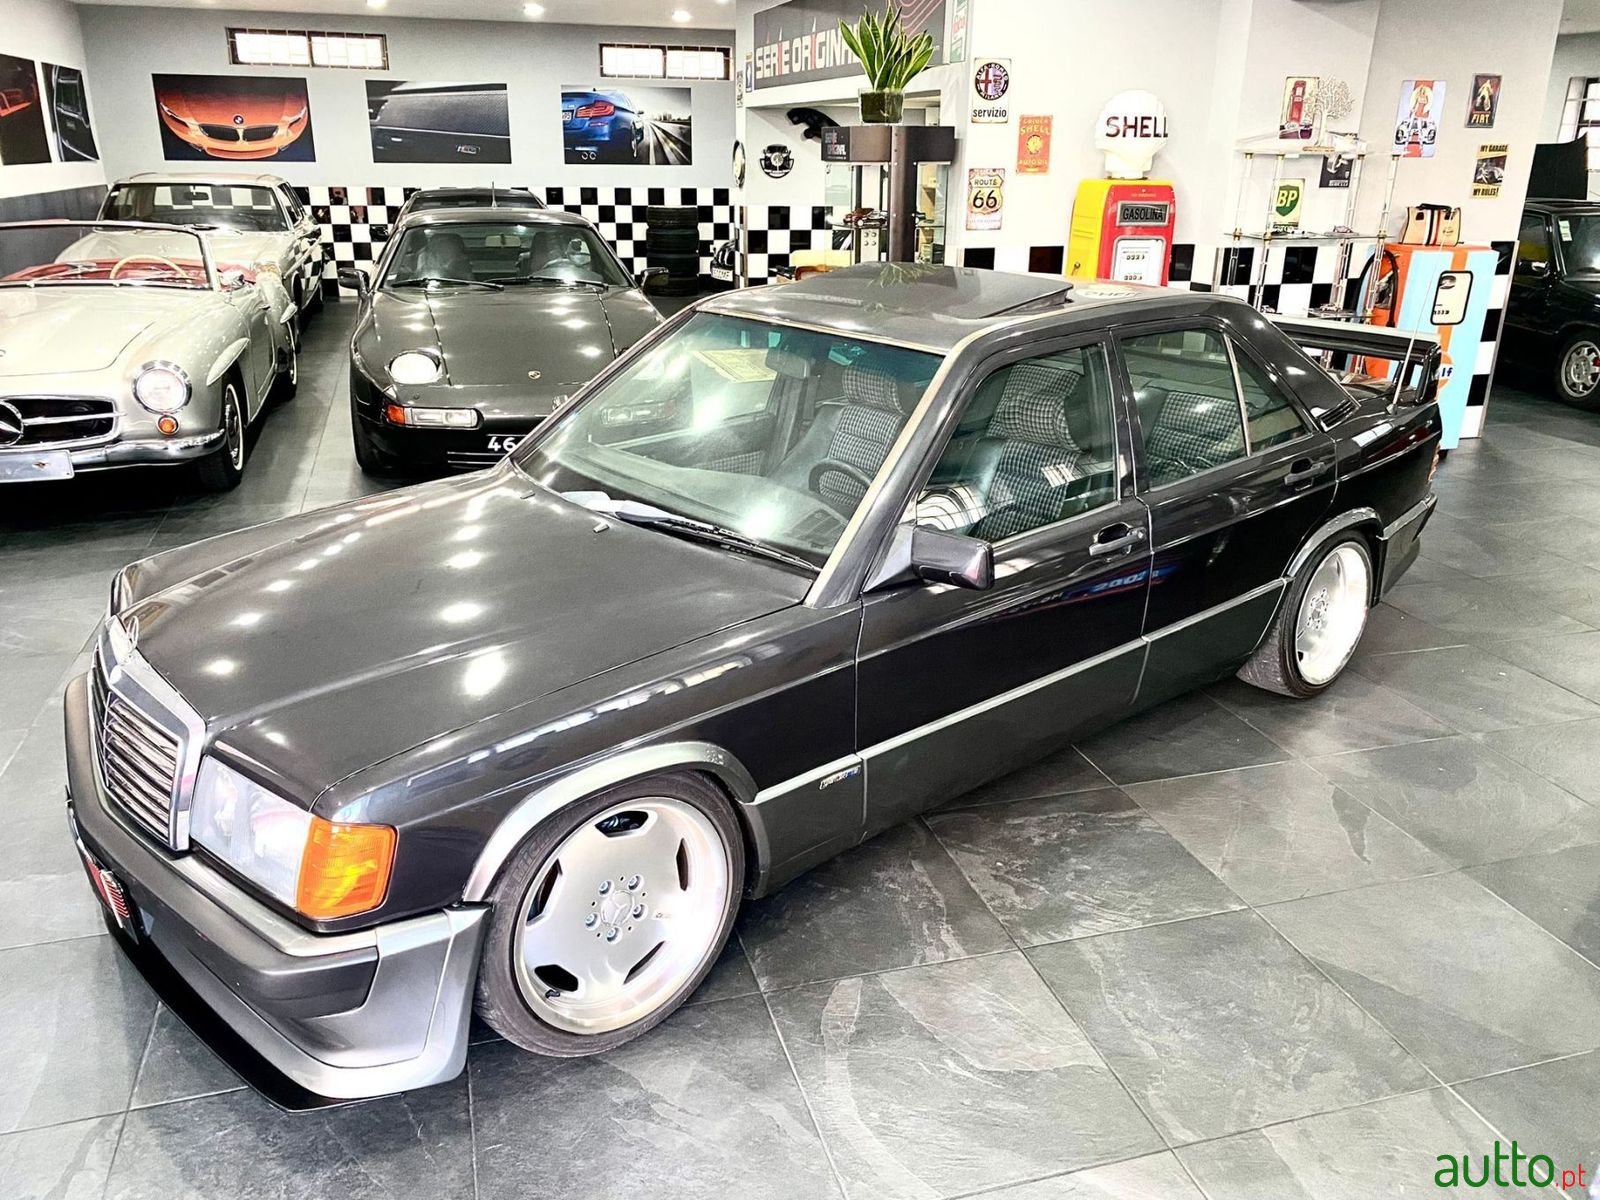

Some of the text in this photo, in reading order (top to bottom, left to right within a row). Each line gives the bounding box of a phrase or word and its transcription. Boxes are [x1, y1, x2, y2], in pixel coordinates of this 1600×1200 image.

[972, 106, 1007, 118] servizio
[1471, 114, 1491, 123] FIAT
[1020, 124, 1051, 136] SHELL
[1105, 115, 1169, 138] SHELL
[1489, 144, 1508, 152] GARAGE
[1277, 190, 1298, 207] BP
[1472, 188, 1481, 196] MY
[973, 189, 997, 209] 66
[1122, 207, 1164, 221] GASOLINA
[487, 436, 517, 452] 46
